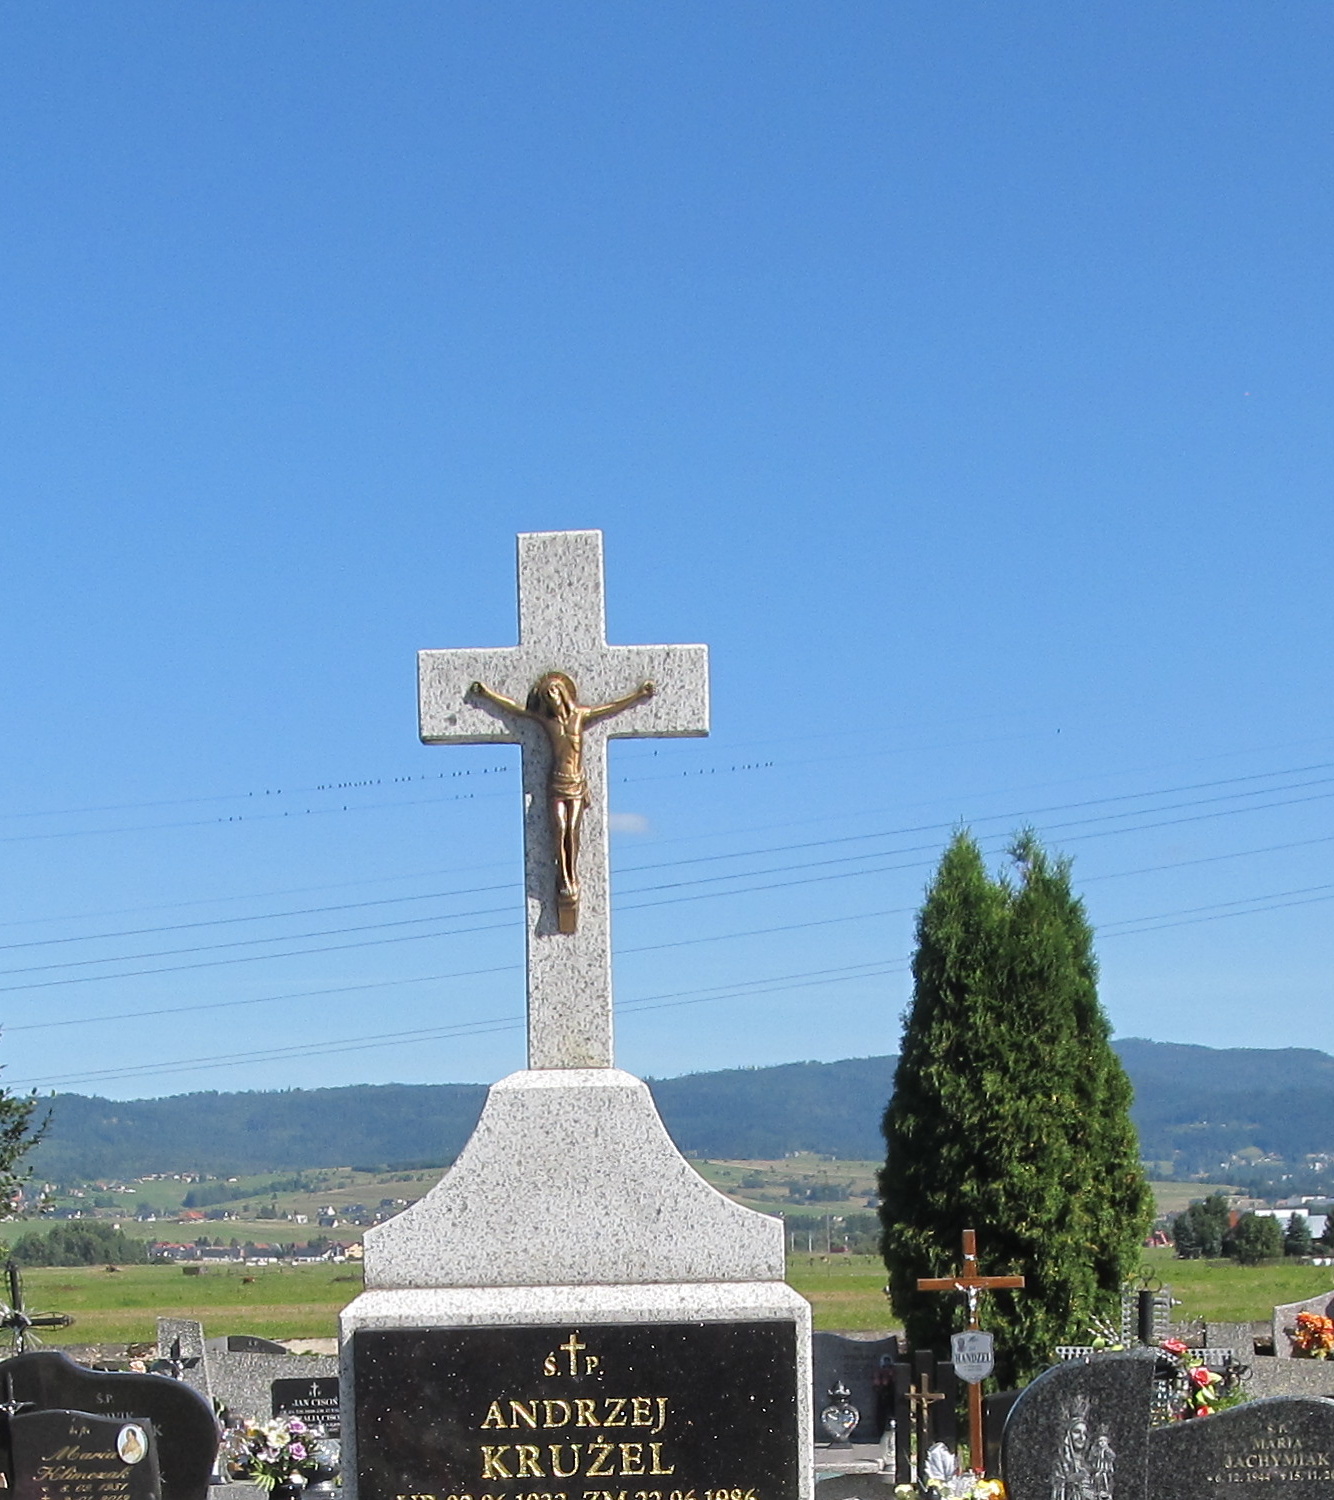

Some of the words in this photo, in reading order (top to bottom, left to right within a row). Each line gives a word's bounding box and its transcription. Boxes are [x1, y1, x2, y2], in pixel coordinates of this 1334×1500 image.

[480, 1397, 668, 1435] ANDRZEJ
[480, 1435, 675, 1479] KRUŻEL
[1223, 1452, 1330, 1468] JACHYMIAK
